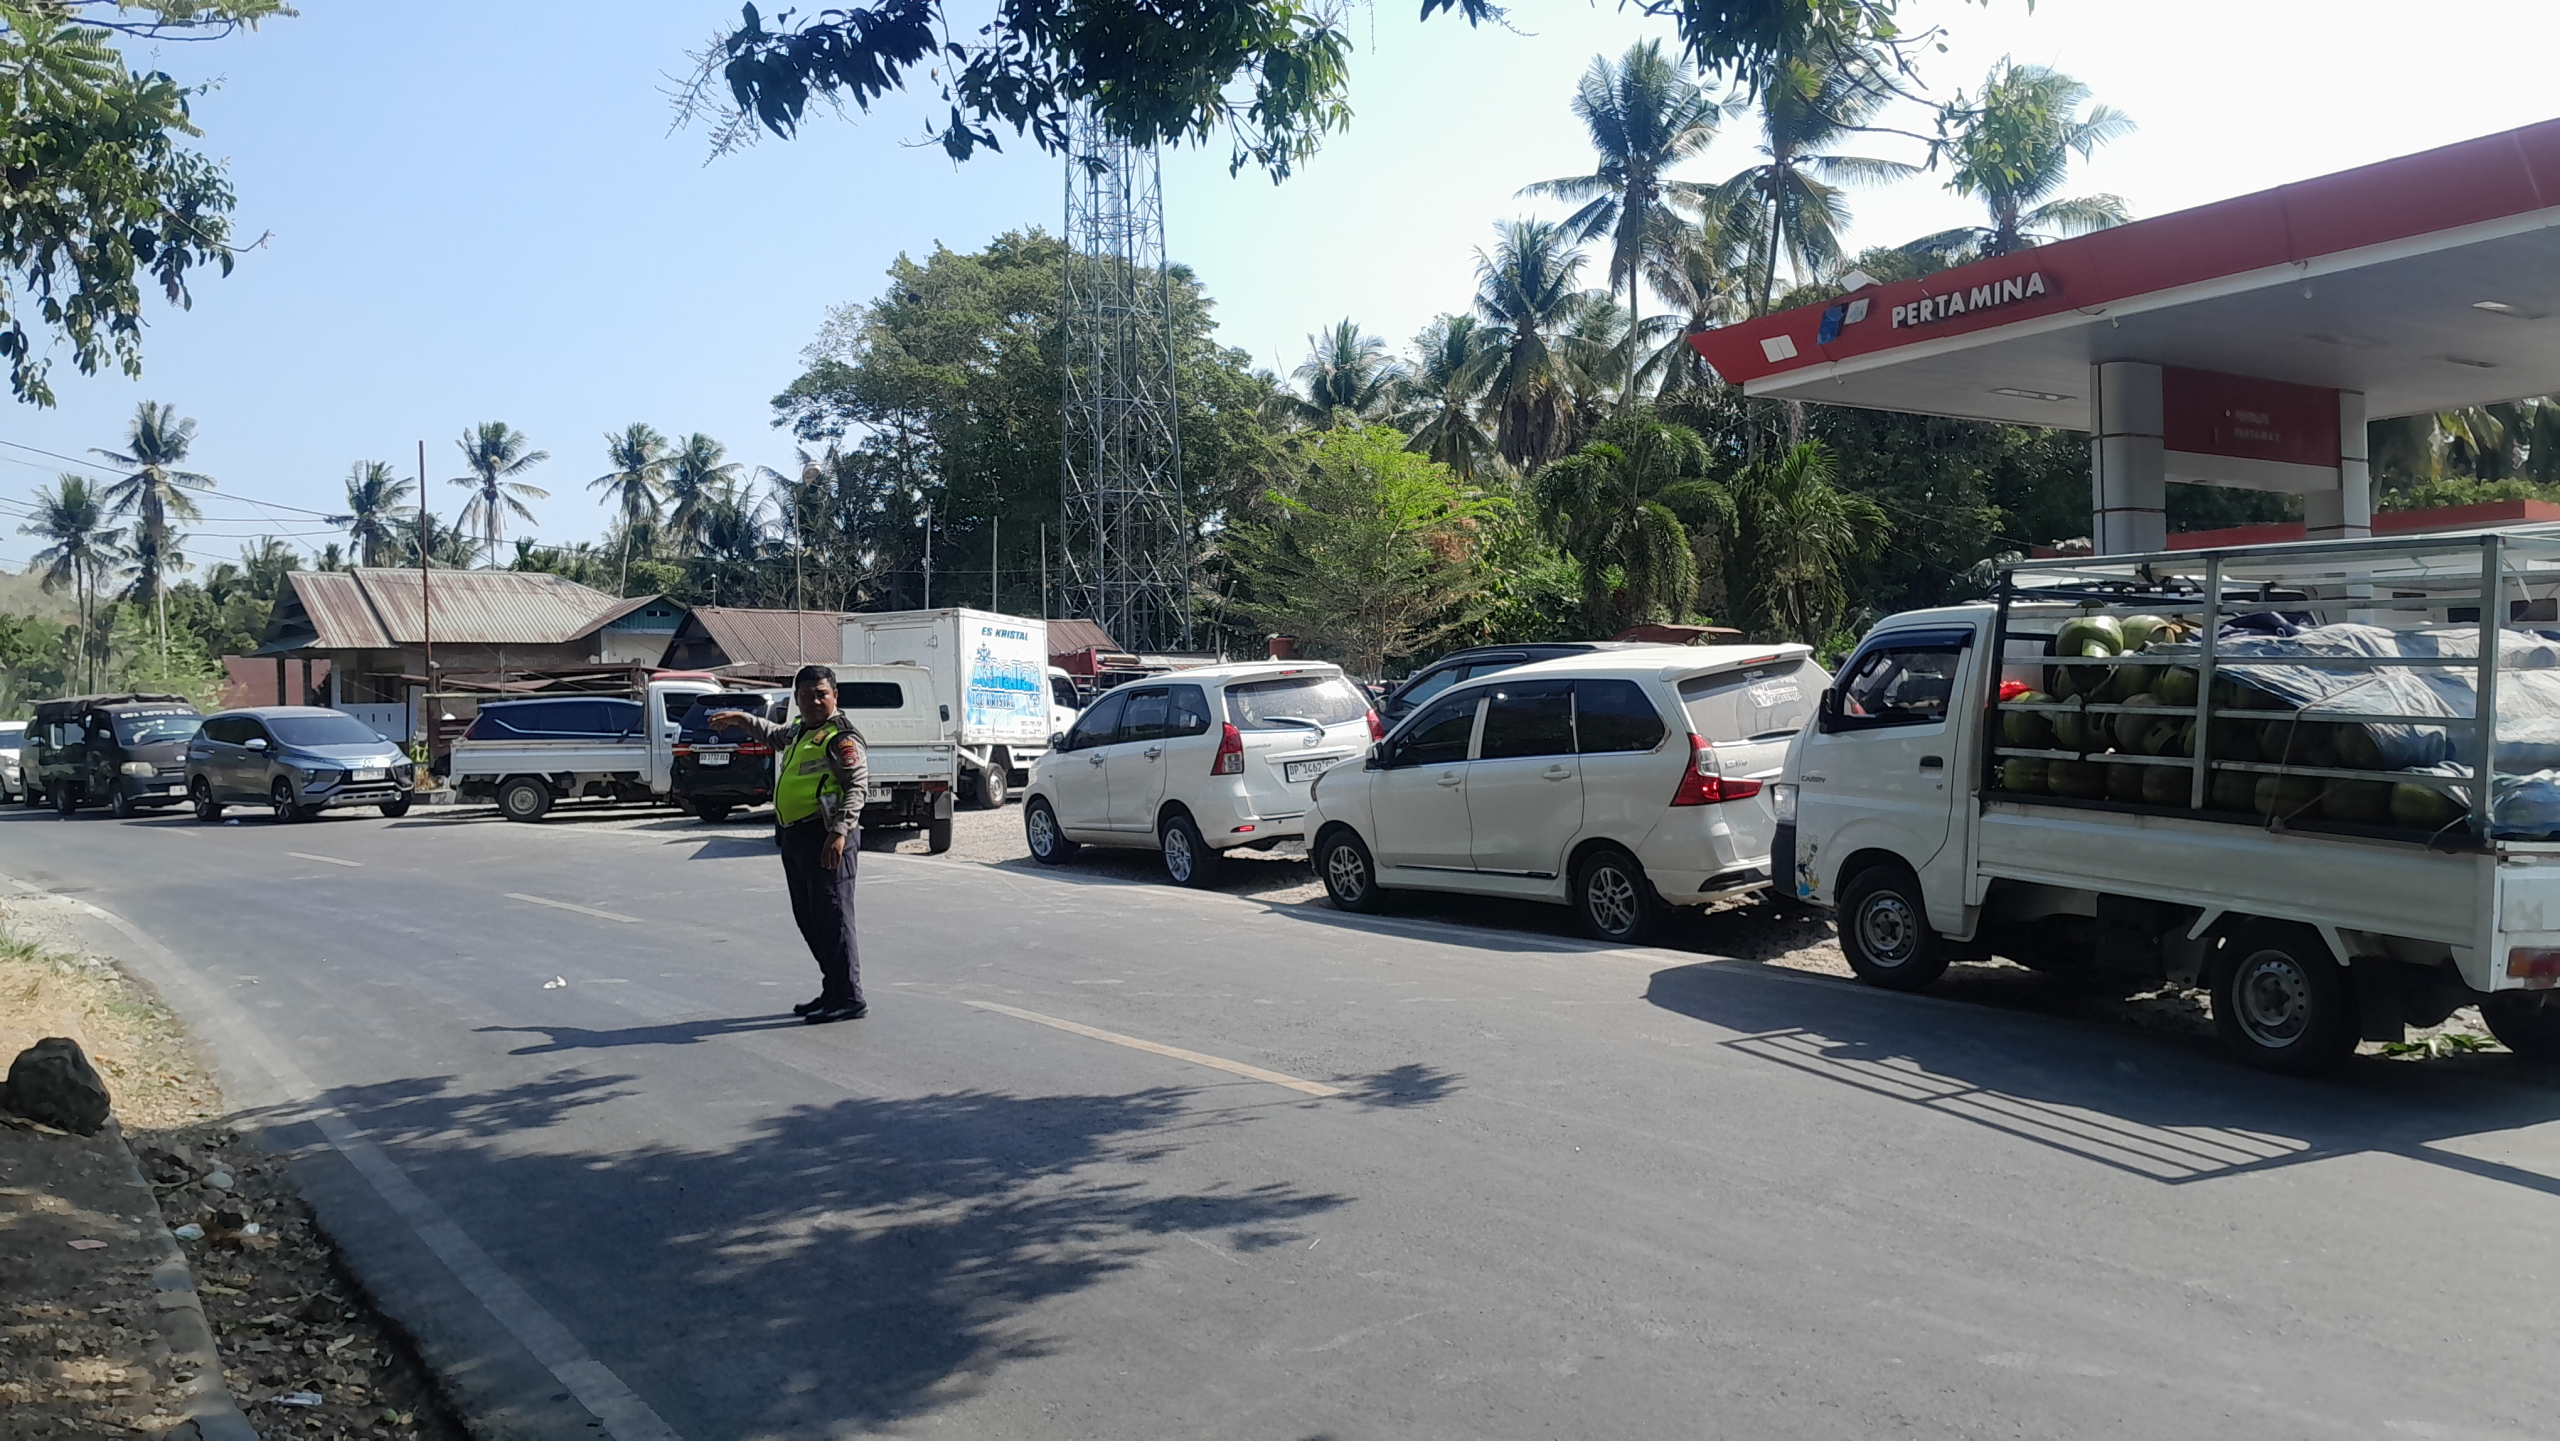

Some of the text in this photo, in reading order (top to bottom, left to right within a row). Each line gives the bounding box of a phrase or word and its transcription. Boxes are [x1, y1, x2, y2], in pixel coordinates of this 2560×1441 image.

[1891, 271, 2045, 329] PERTAMINA
[981, 626, 1029, 641] ES KRISTAL
[1288, 764, 1299, 775] DP
[1302, 762, 1323, 774] 1462
[1800, 775, 1826, 784] CARRY
[880, 788, 891, 797] KP
